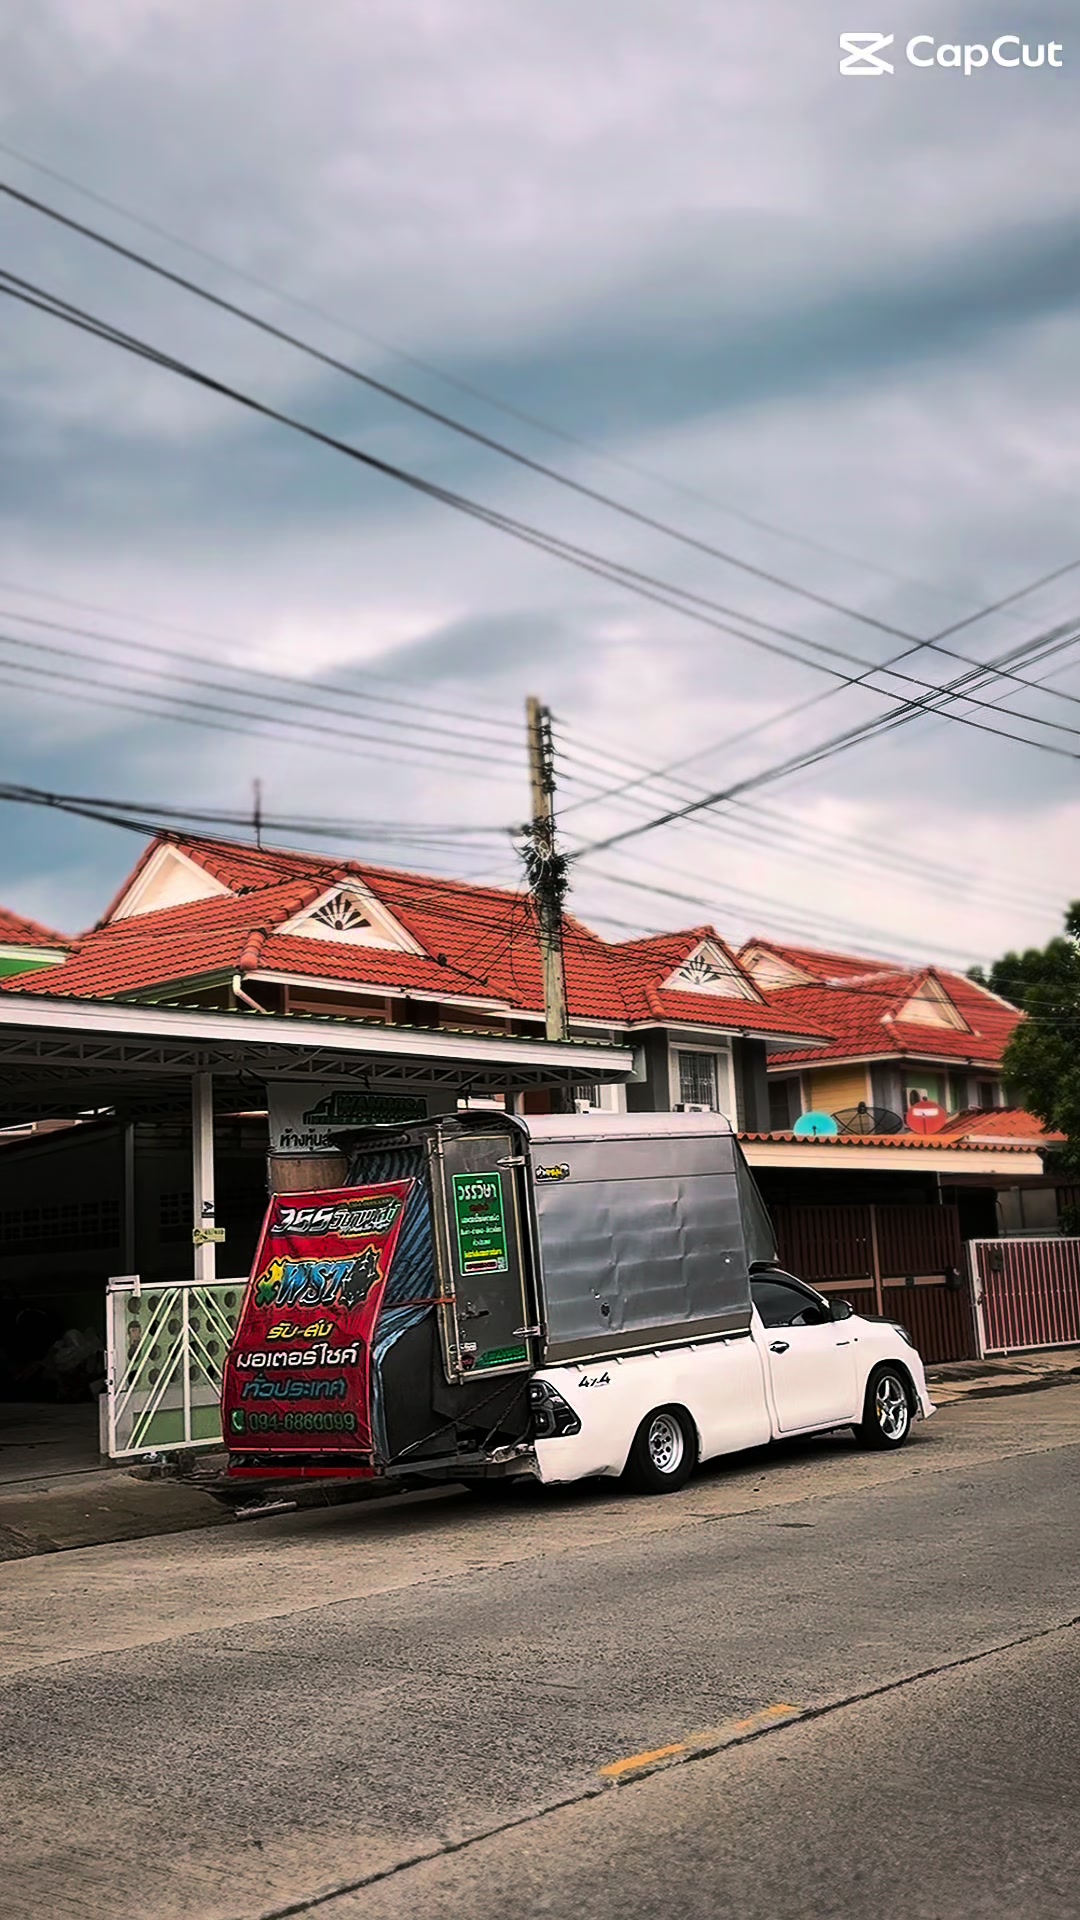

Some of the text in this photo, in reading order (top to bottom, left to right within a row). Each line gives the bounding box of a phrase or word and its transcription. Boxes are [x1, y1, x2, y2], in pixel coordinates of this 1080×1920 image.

[276, 1261, 356, 1305] WST
[266, 1319, 333, 1339] รับ-ส่ง
[242, 1374, 346, 1398] ทั่วประเทศ
[249, 1413, 355, 1430] 094-6860099
